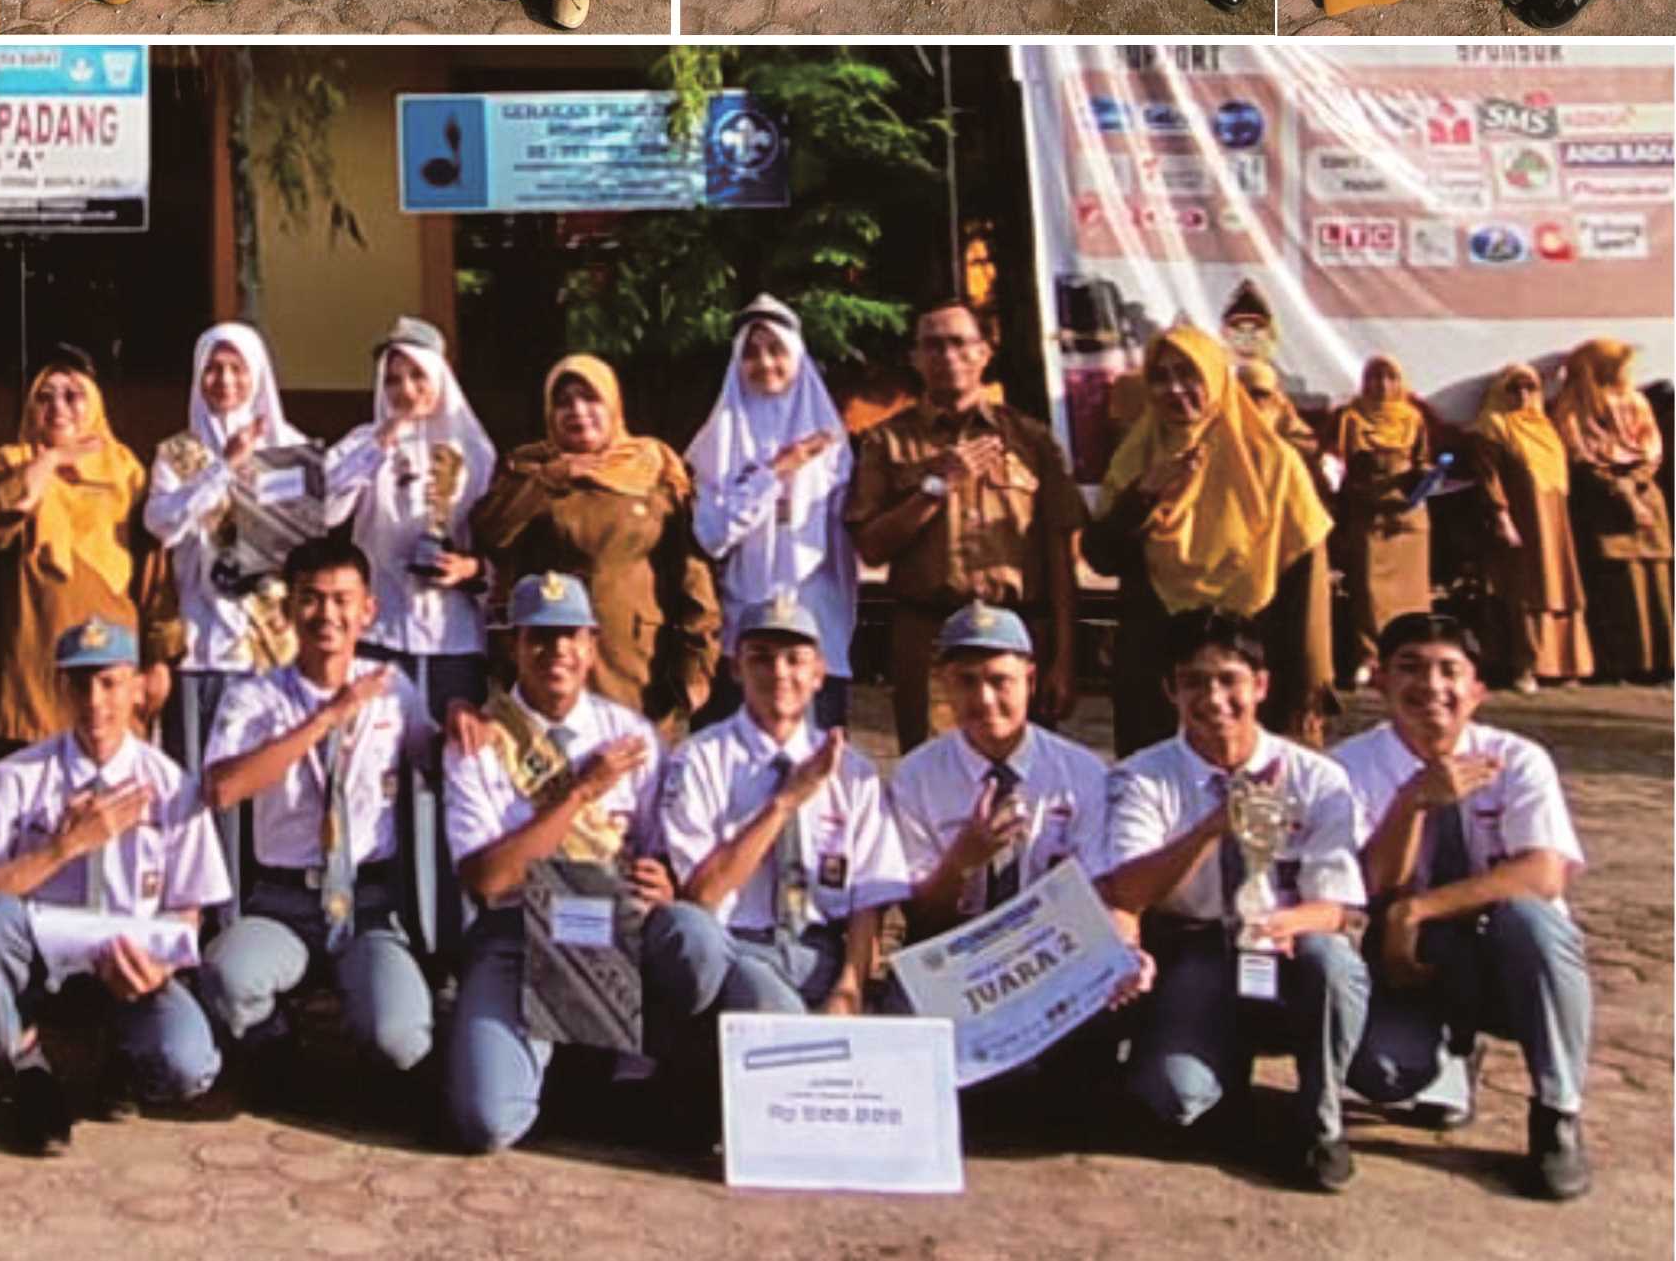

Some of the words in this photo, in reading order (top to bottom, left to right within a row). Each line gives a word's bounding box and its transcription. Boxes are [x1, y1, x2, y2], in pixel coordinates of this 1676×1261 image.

[1482, 106, 1549, 131] SMS
[962, 951, 1059, 1015] JUARA
[1059, 933, 1081, 956] 2
